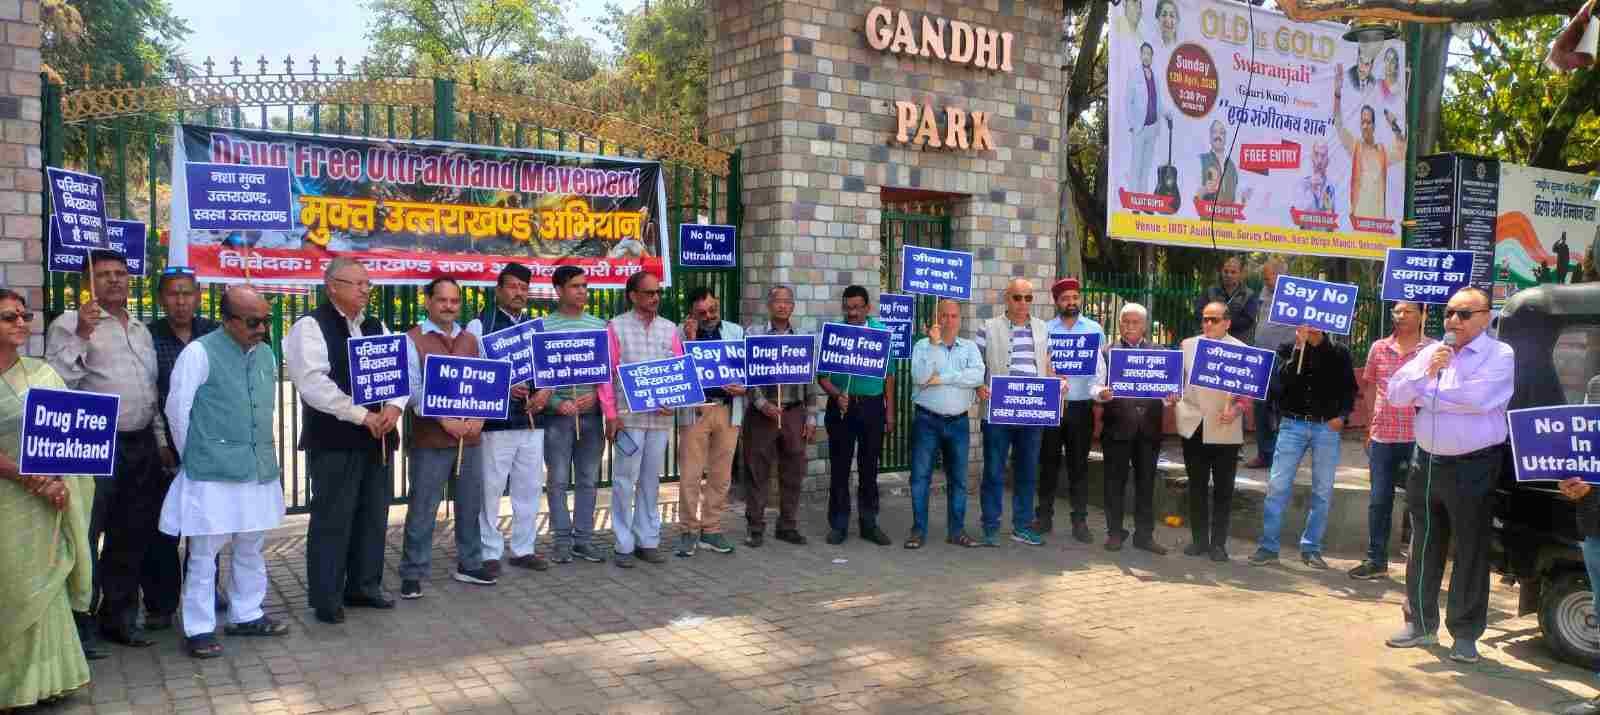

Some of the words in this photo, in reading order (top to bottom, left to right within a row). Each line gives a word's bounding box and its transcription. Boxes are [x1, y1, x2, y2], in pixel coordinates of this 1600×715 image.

[865, 6, 1013, 71] GANDHI
[1202, 8, 1249, 46] OLD
[1275, 25, 1336, 64] GOLD
[1176, 55, 1210, 77] Sunday
[895, 100, 994, 151] PARK
[1244, 150, 1268, 162] FREE
[1270, 150, 1297, 164] ENTRY
[295, 143, 361, 181] Free
[366, 147, 516, 192] Uttrakhand
[520, 159, 640, 199] Movement
[56, 176, 89, 195] परिवार
[211, 171, 235, 184] नशा
[239, 173, 266, 189] मुक्त
[207, 190, 272, 204] उत्तराखण्ड,
[62, 212, 78, 225] का
[193, 209, 226, 222] स्वस्थ
[228, 209, 287, 223] उत्तराखण्ड
[298, 194, 375, 246] मुक्त
[383, 198, 531, 241] उत्तराखण्ड
[540, 193, 642, 241] अभियान
[72, 226, 81, 242] है
[690, 230, 703, 240] No
[705, 231, 726, 243] Drug
[704, 240, 713, 251] In
[218, 249, 312, 272] निवेदक:
[437, 260, 484, 273] राज्य
[683, 250, 732, 262] Uttrakhand
[912, 252, 945, 265] जीवन
[947, 257, 963, 267] को
[1406, 256, 1438, 268] नशा
[1442, 254, 1455, 270] है
[1392, 270, 1440, 282] समाज
[1443, 272, 1465, 283] का
[910, 279, 929, 289] नशे
[932, 281, 948, 291] को
[1403, 283, 1450, 299] दुश्मन
[1283, 282, 1319, 302] Say
[1322, 287, 1349, 305] No
[893, 302, 909, 313] Free
[1277, 301, 1298, 318] To
[1304, 305, 1348, 330] Drug
[355, 341, 387, 357] परिवार
[491, 334, 521, 352] जीवन
[544, 337, 596, 350] उत्तराखण्ड
[828, 332, 856, 351] Drug
[857, 336, 883, 352] Free
[547, 352, 562, 364] को
[692, 346, 721, 362] Say
[725, 345, 746, 359] No
[752, 346, 778, 361] Drug
[782, 345, 808, 358] Free
[822, 350, 885, 370] Uttrakhand
[1205, 346, 1242, 361] जीवन
[1243, 354, 1263, 365] को
[629, 363, 672, 380] परिवार
[673, 359, 686, 372] में
[748, 361, 811, 377] Uttrakhand
[1127, 355, 1145, 365] नशा
[1146, 355, 1166, 369] मुक्त
[357, 374, 371, 385] का
[374, 369, 402, 383] कारण
[439, 364, 458, 379] No
[463, 365, 496, 383] Drug
[537, 368, 555, 379] नशे
[557, 366, 571, 377] को
[696, 366, 715, 380] To
[718, 366, 746, 379] Dru
[459, 382, 473, 394] In
[633, 388, 653, 399] का
[654, 381, 692, 395] कारण
[1008, 382, 1024, 393] नशा
[1197, 373, 1220, 386] नशे
[1222, 377, 1242, 389] को
[1242, 383, 1258, 393] ना
[364, 386, 373, 400] है
[375, 384, 396, 396] नशा
[427, 394, 504, 411] Uttrakhand
[645, 395, 656, 408] है
[34, 404, 72, 433] Drug
[75, 409, 108, 431] Free
[1535, 417, 1565, 434] No
[26, 435, 110, 459] Uttrakhand
[1570, 435, 1592, 452] In
